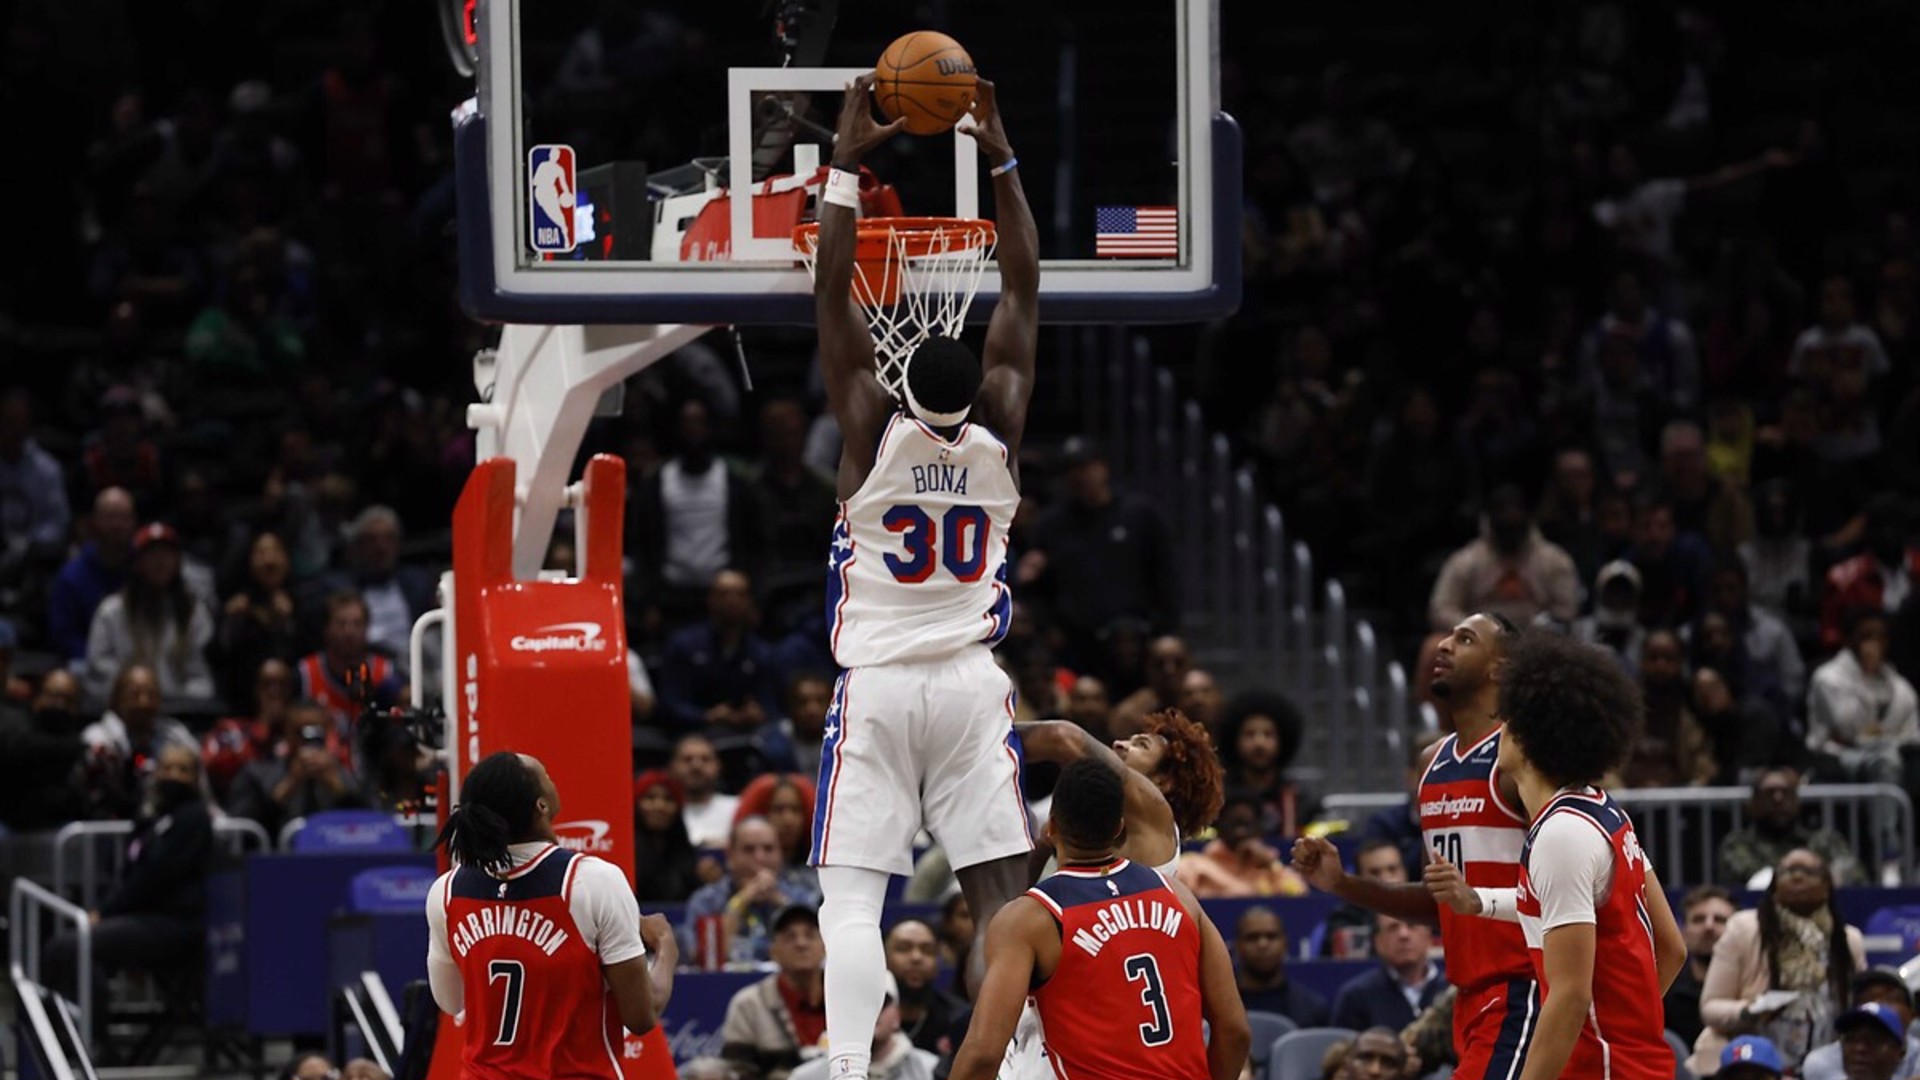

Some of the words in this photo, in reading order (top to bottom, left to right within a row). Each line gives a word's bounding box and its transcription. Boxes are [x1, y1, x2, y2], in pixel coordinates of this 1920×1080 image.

[538, 227, 560, 245] NBA
[911, 463, 968, 495] BONA
[882, 504, 991, 584] 30
[465, 653, 479, 765] ards
[453, 905, 568, 957] CARRINGTON
[1072, 899, 1183, 957] McCOLLUM
[488, 959, 525, 1046] 7
[1124, 953, 1174, 1047] 3
